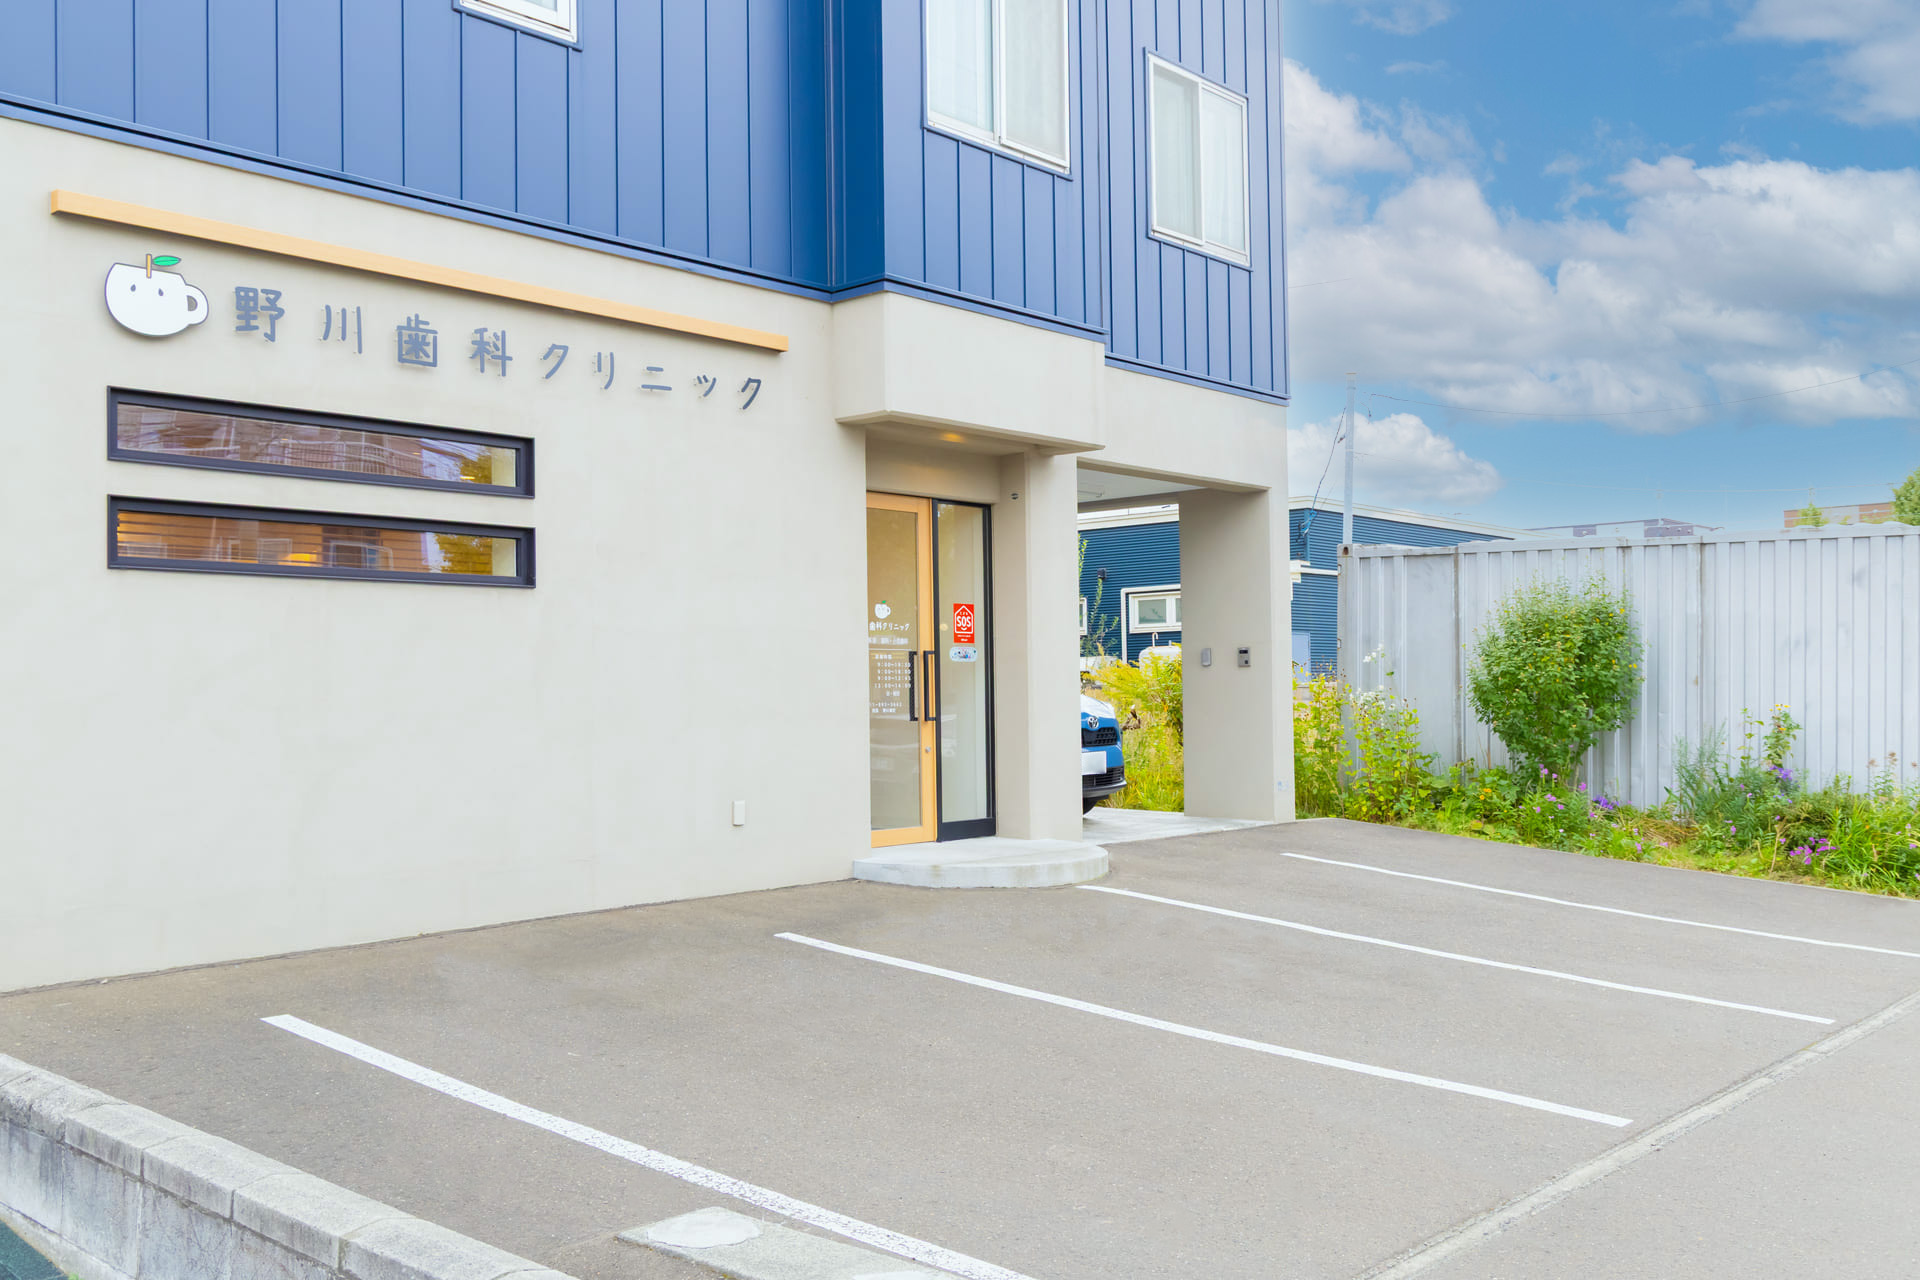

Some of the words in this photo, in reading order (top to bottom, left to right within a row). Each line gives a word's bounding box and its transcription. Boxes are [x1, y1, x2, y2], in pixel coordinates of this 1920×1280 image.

[234, 286, 762, 410] 野川歯科クリニック
[956, 616, 972, 627] SOS
